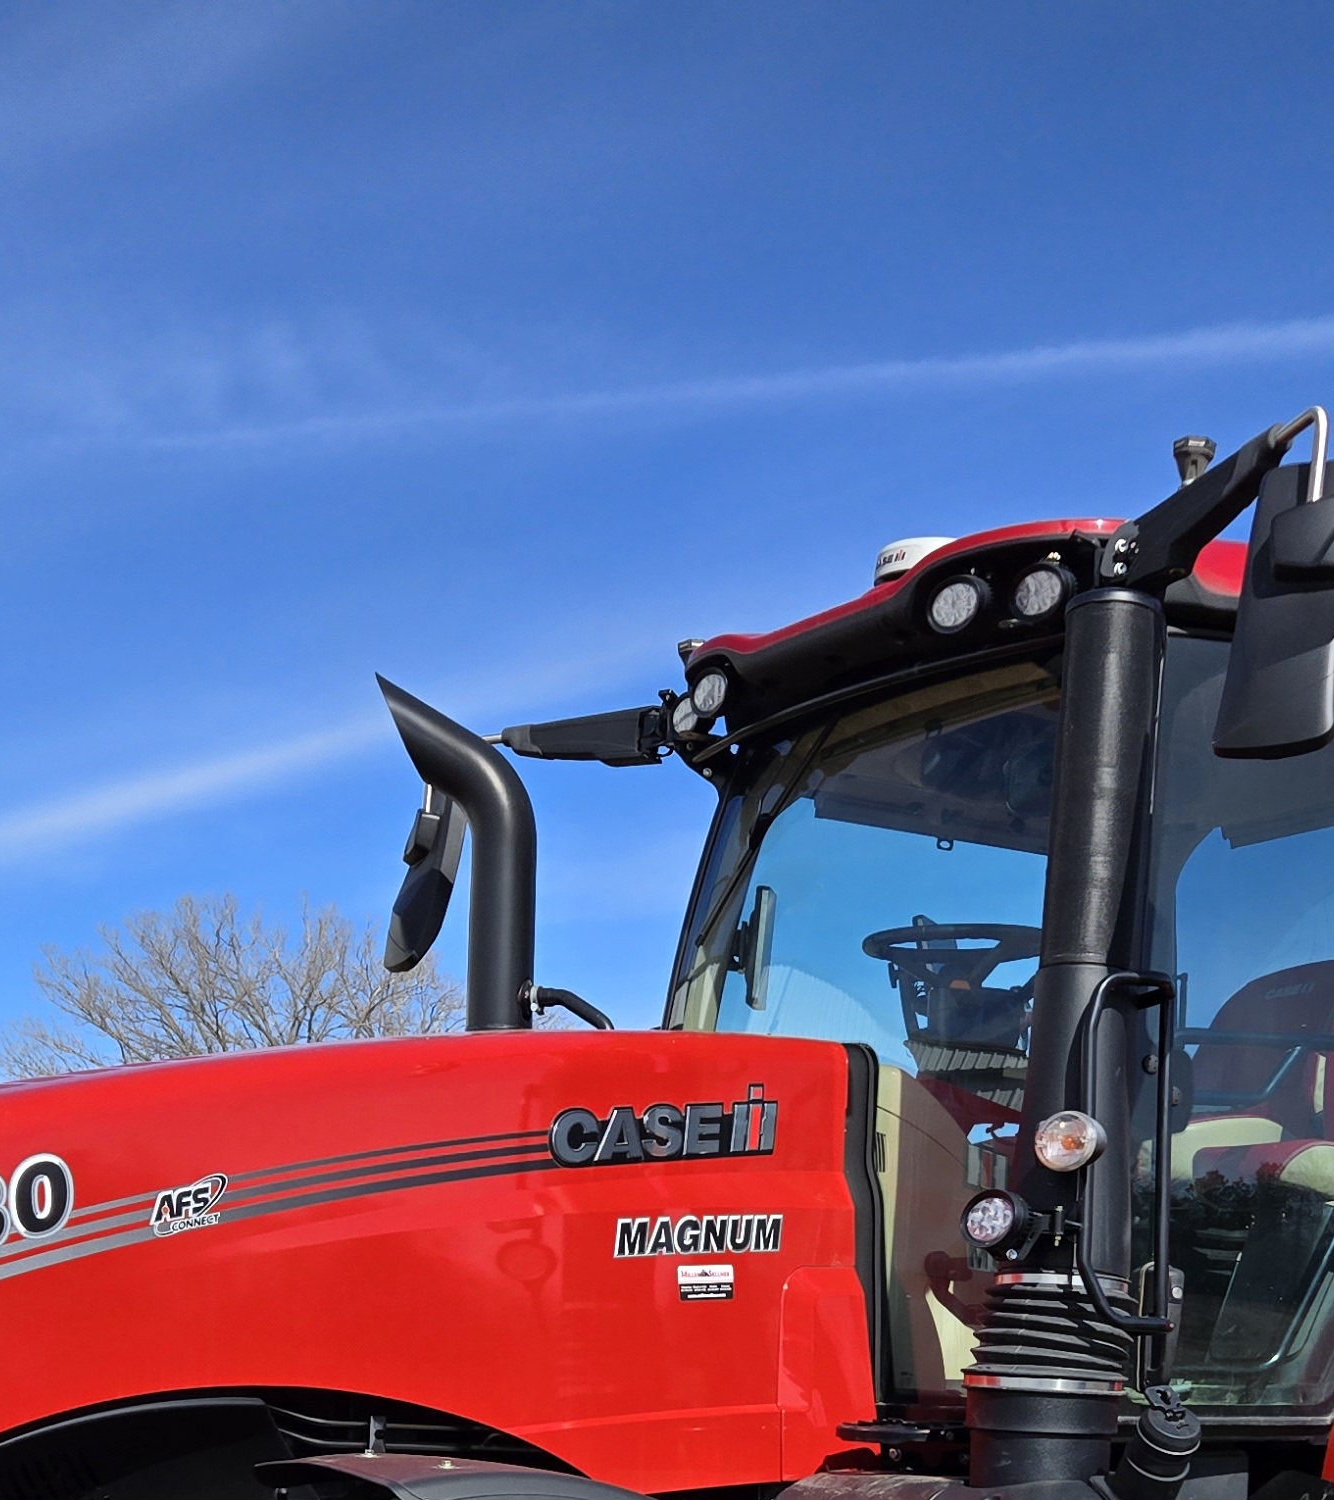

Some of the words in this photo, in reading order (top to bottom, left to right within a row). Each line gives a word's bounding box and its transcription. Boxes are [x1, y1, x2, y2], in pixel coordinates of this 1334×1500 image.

[549, 1103, 724, 1168] CASE
[151, 1183, 213, 1225] AFS
[171, 1213, 220, 1232] CONNECT
[613, 1214, 783, 1258] MAGNUM
